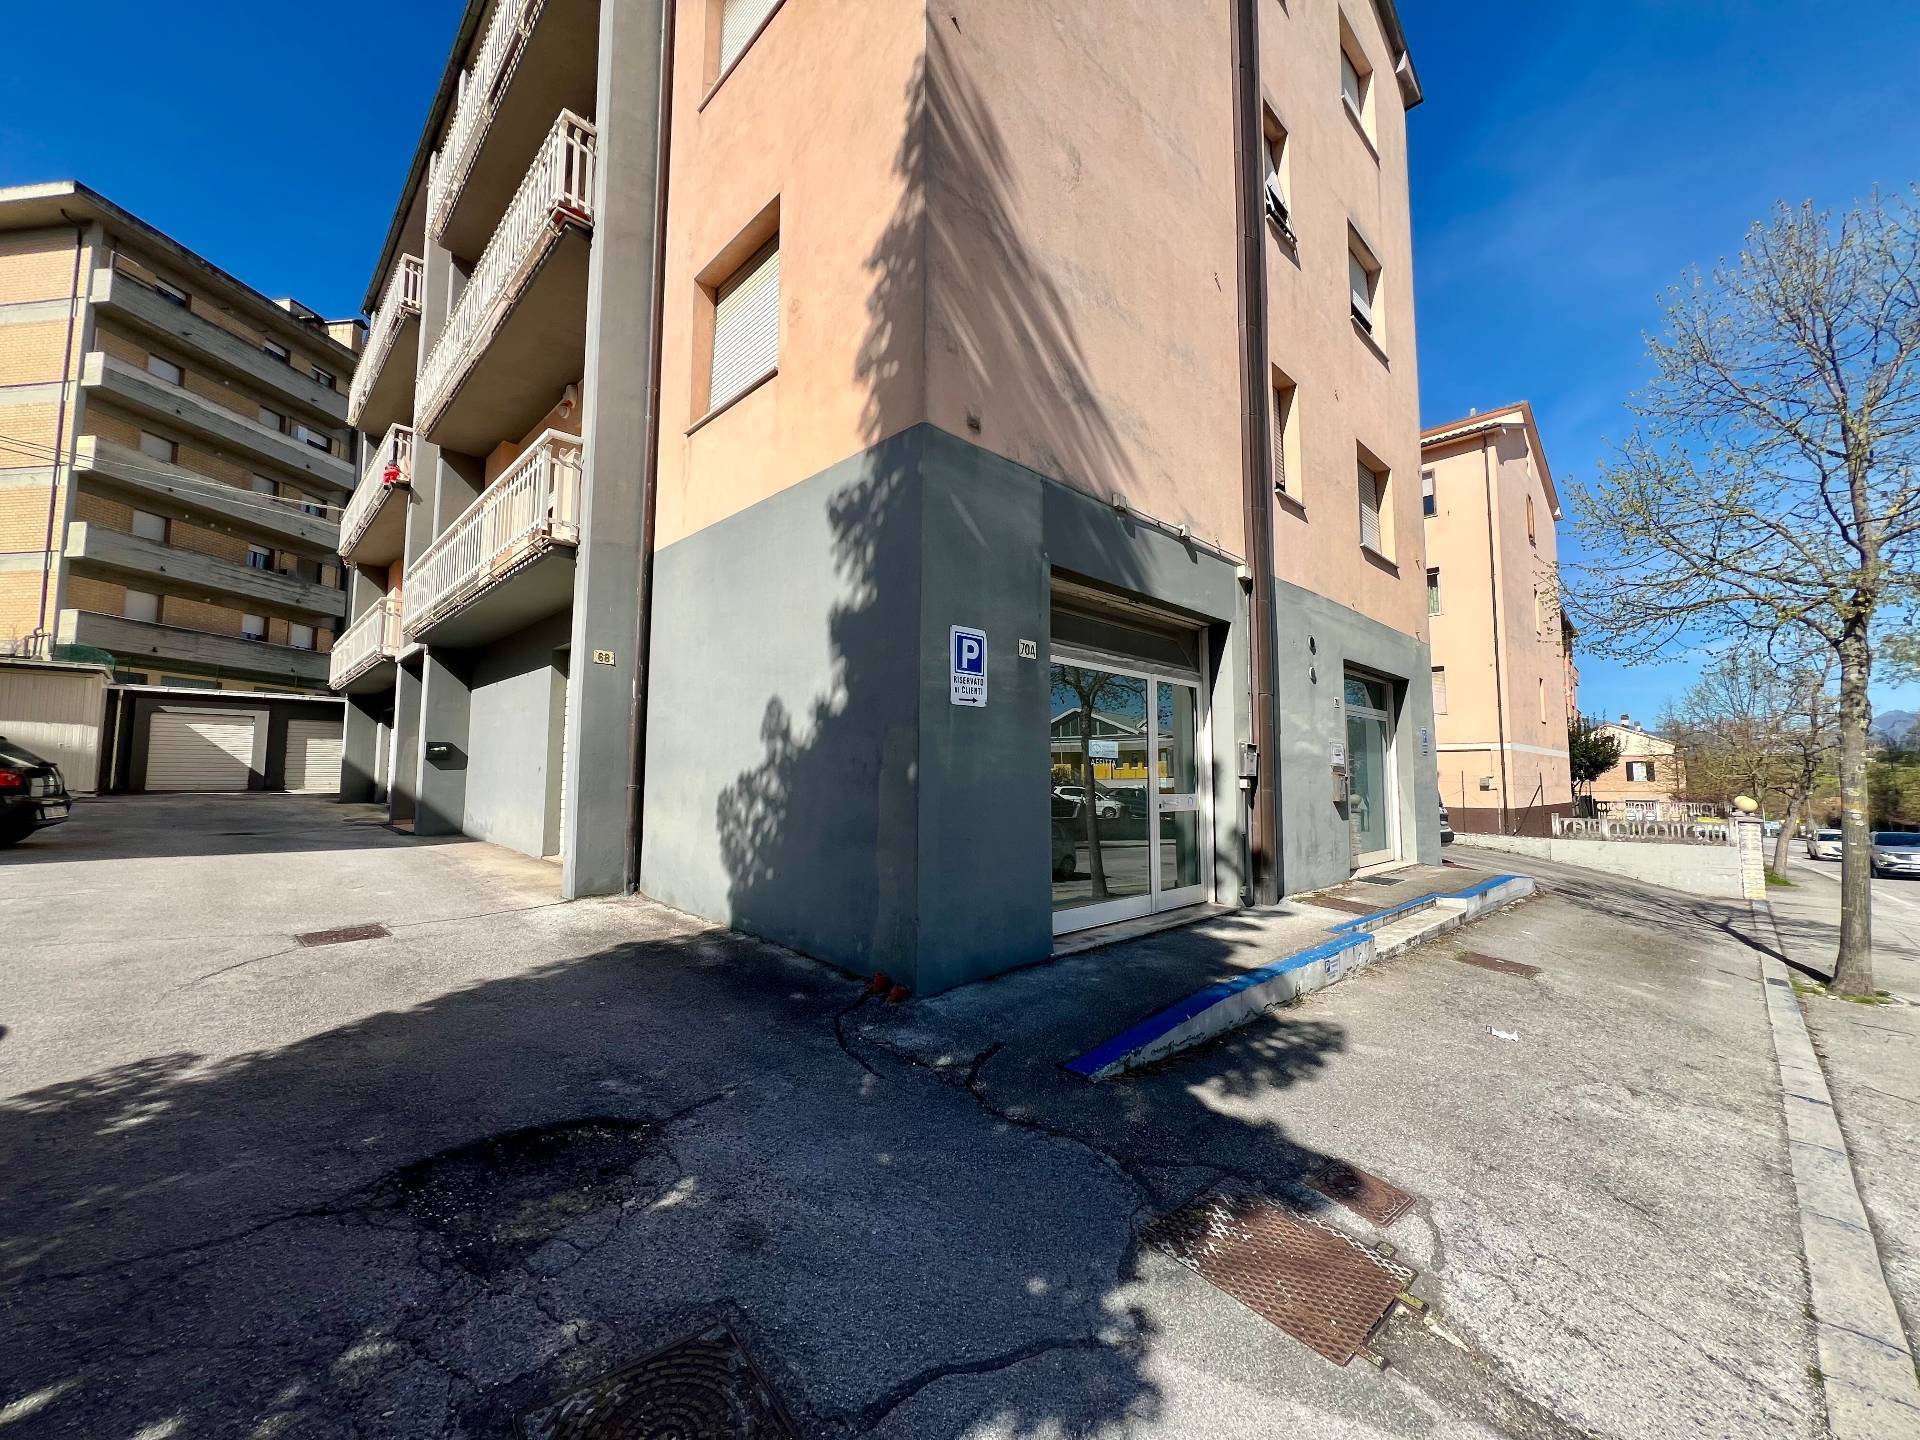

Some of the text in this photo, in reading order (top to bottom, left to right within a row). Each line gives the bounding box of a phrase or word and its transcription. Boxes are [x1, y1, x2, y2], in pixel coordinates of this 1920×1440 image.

[598, 652, 610, 662] 68
[961, 639, 980, 669] P
[953, 675, 984, 687] RISERVATO
[961, 686, 983, 696] CLIENTI
